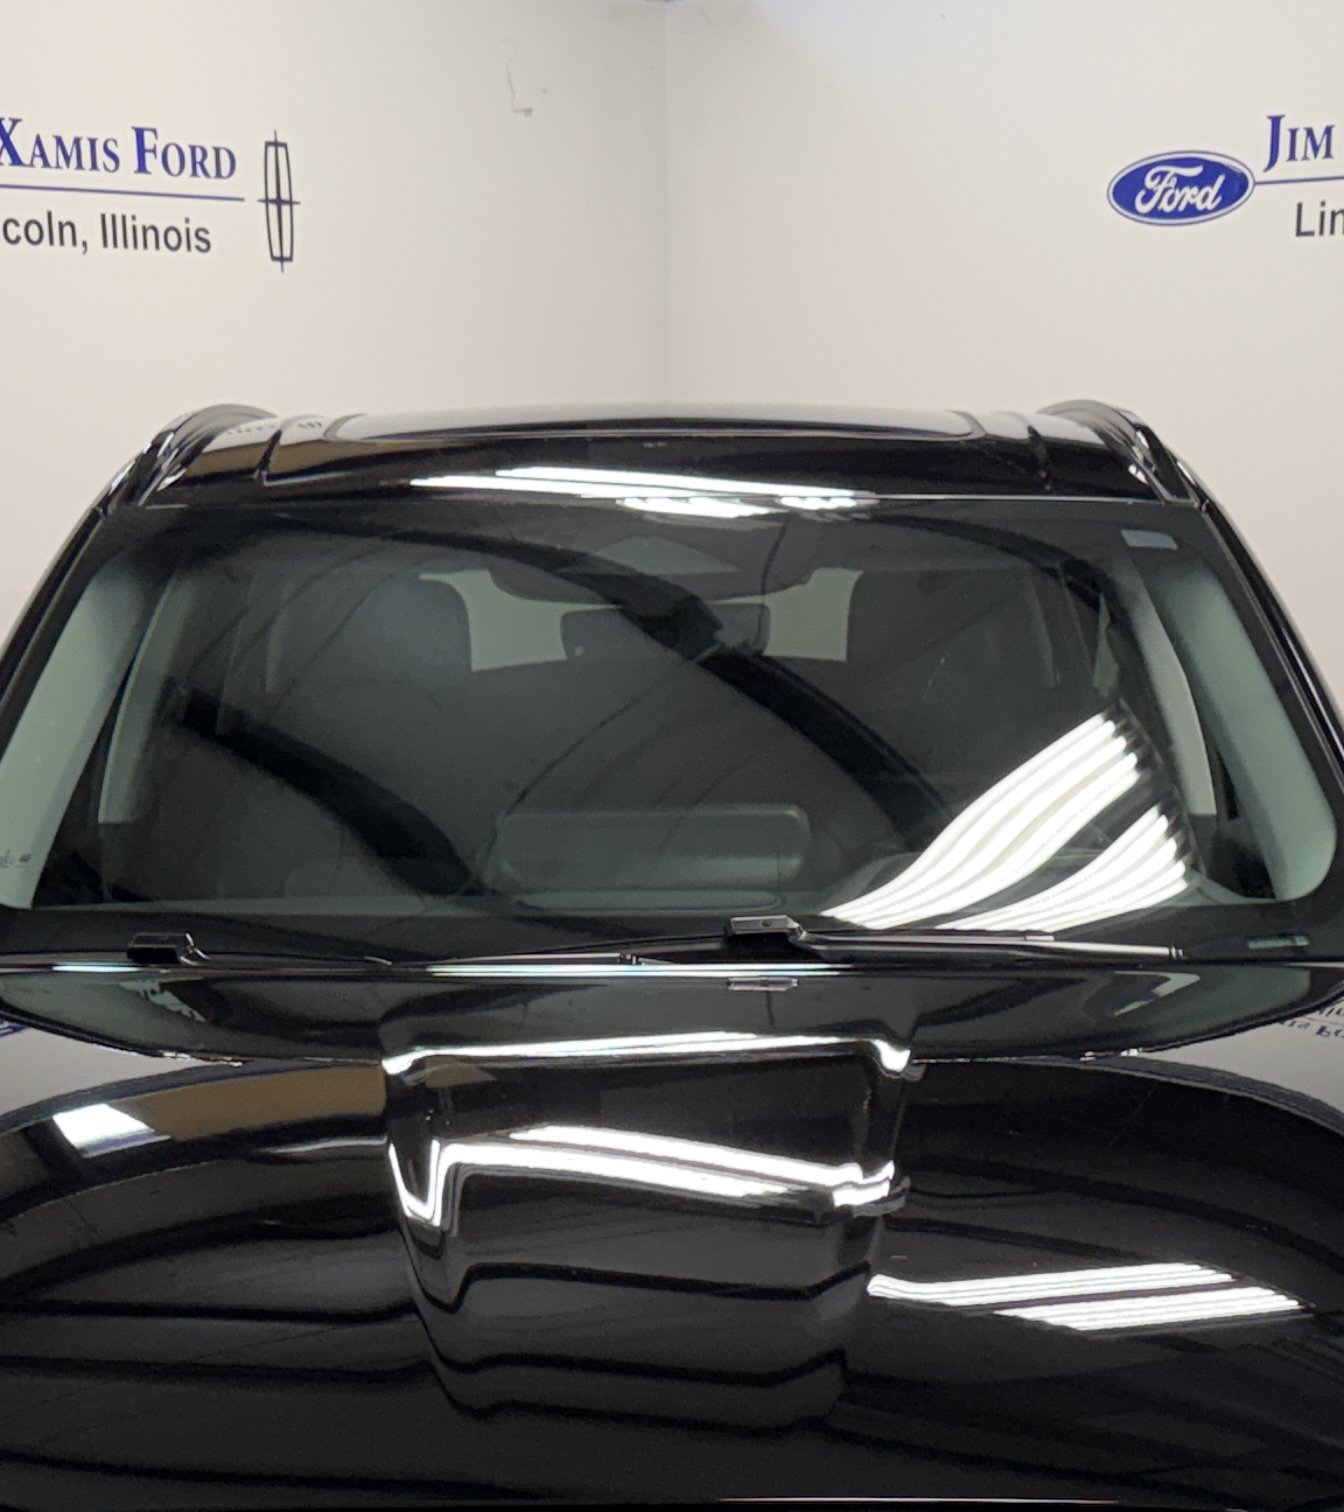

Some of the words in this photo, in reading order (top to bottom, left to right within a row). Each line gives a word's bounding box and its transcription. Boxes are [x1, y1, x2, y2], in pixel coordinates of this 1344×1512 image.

[131, 126, 237, 179] FORD
[1263, 114, 1334, 173] JIM
[1133, 161, 1223, 214] Ford
[100, 213, 211, 253] Illinois
